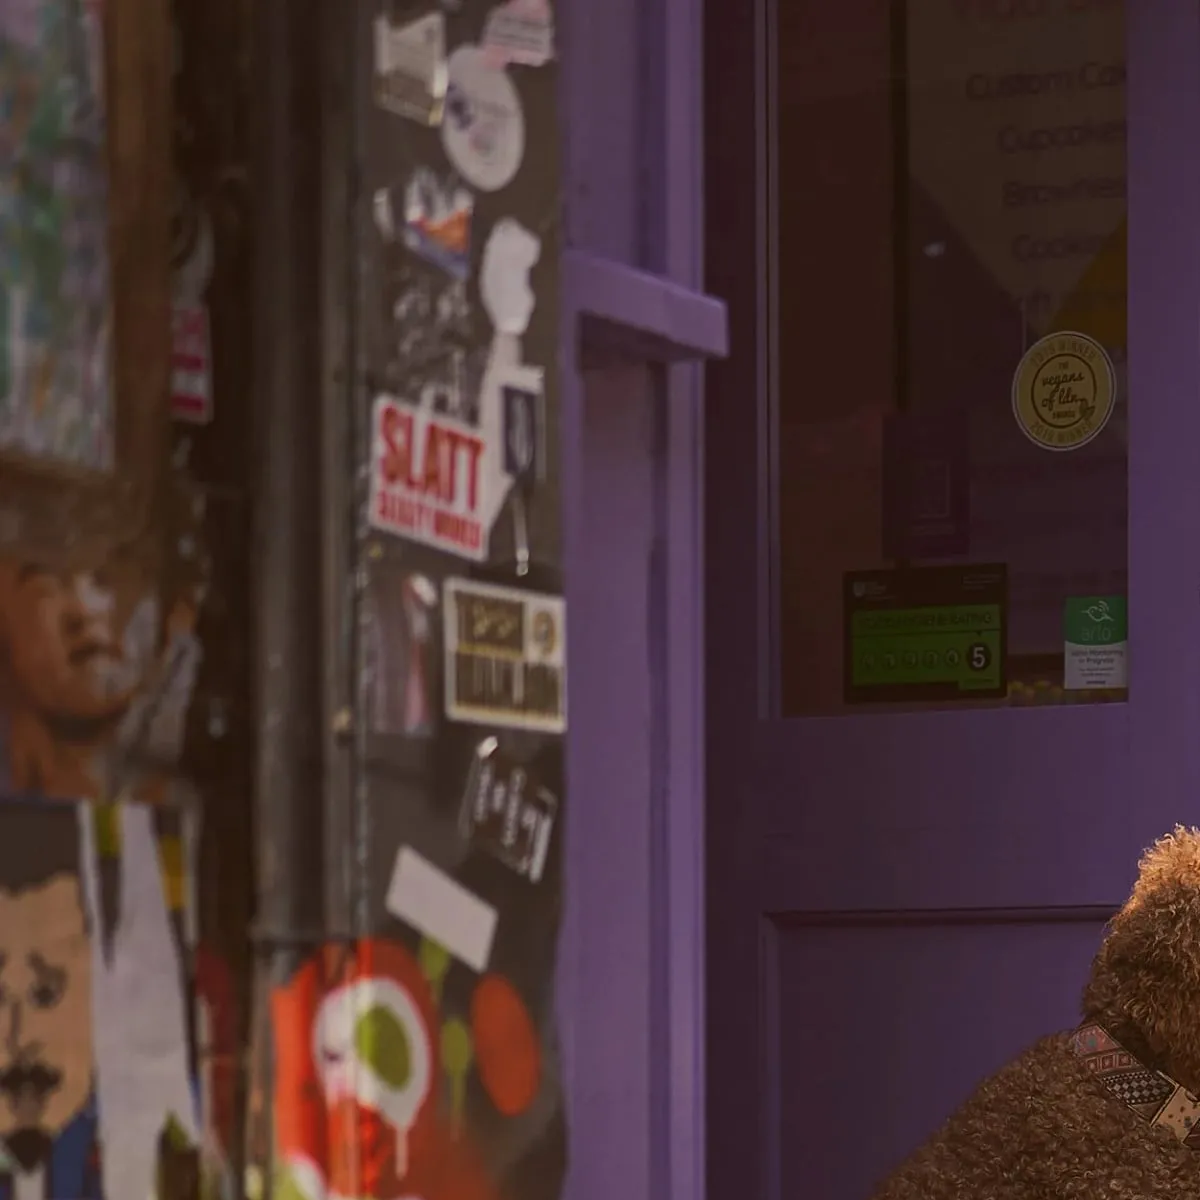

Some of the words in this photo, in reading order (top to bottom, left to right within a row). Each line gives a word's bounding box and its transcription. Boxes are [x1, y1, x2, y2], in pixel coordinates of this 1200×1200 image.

[1042, 372, 1085, 388] vegans
[1042, 387, 1058, 411] of
[380, 406, 485, 511] SLATT
[1081, 623, 1112, 641] arlo
[971, 646, 987, 668] 5
